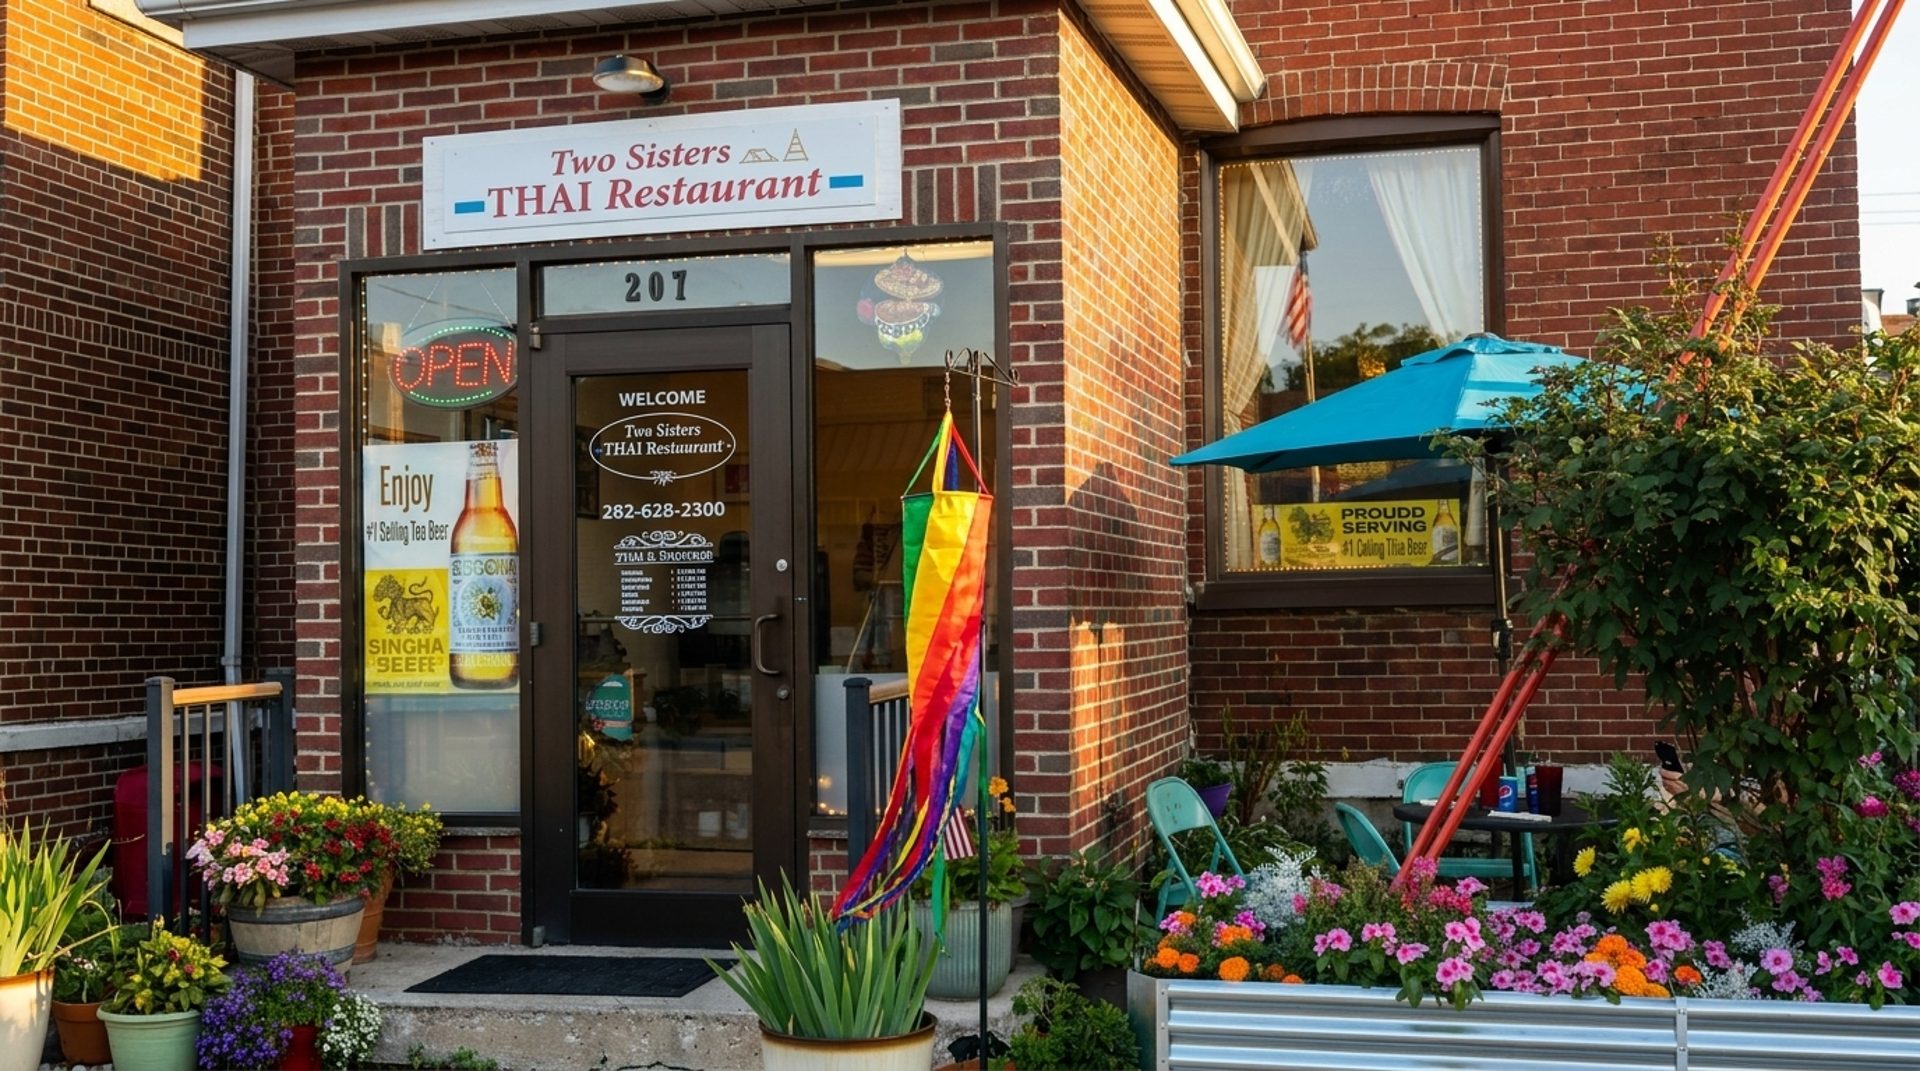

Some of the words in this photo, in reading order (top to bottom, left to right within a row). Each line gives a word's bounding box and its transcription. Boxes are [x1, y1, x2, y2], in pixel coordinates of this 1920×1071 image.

[551, 148, 616, 177] Two
[625, 143, 731, 171] Sisters
[488, 181, 592, 218] THAI
[605, 168, 823, 210] Restaurant
[624, 269, 688, 302] 207
[394, 340, 514, 390] OPEN
[618, 390, 706, 407] WELCOME
[624, 424, 652, 438] Two
[656, 423, 701, 438] Sisters
[603, 442, 642, 456] THAI
[380, 464, 433, 513] Enjoy
[602, 501, 725, 520] 282-628-2300
[1341, 507, 1425, 520] PROUDD
[428, 519, 449, 541] Beer
[1342, 520, 1427, 534] SERVING
[368, 638, 444, 655] SINGHA
